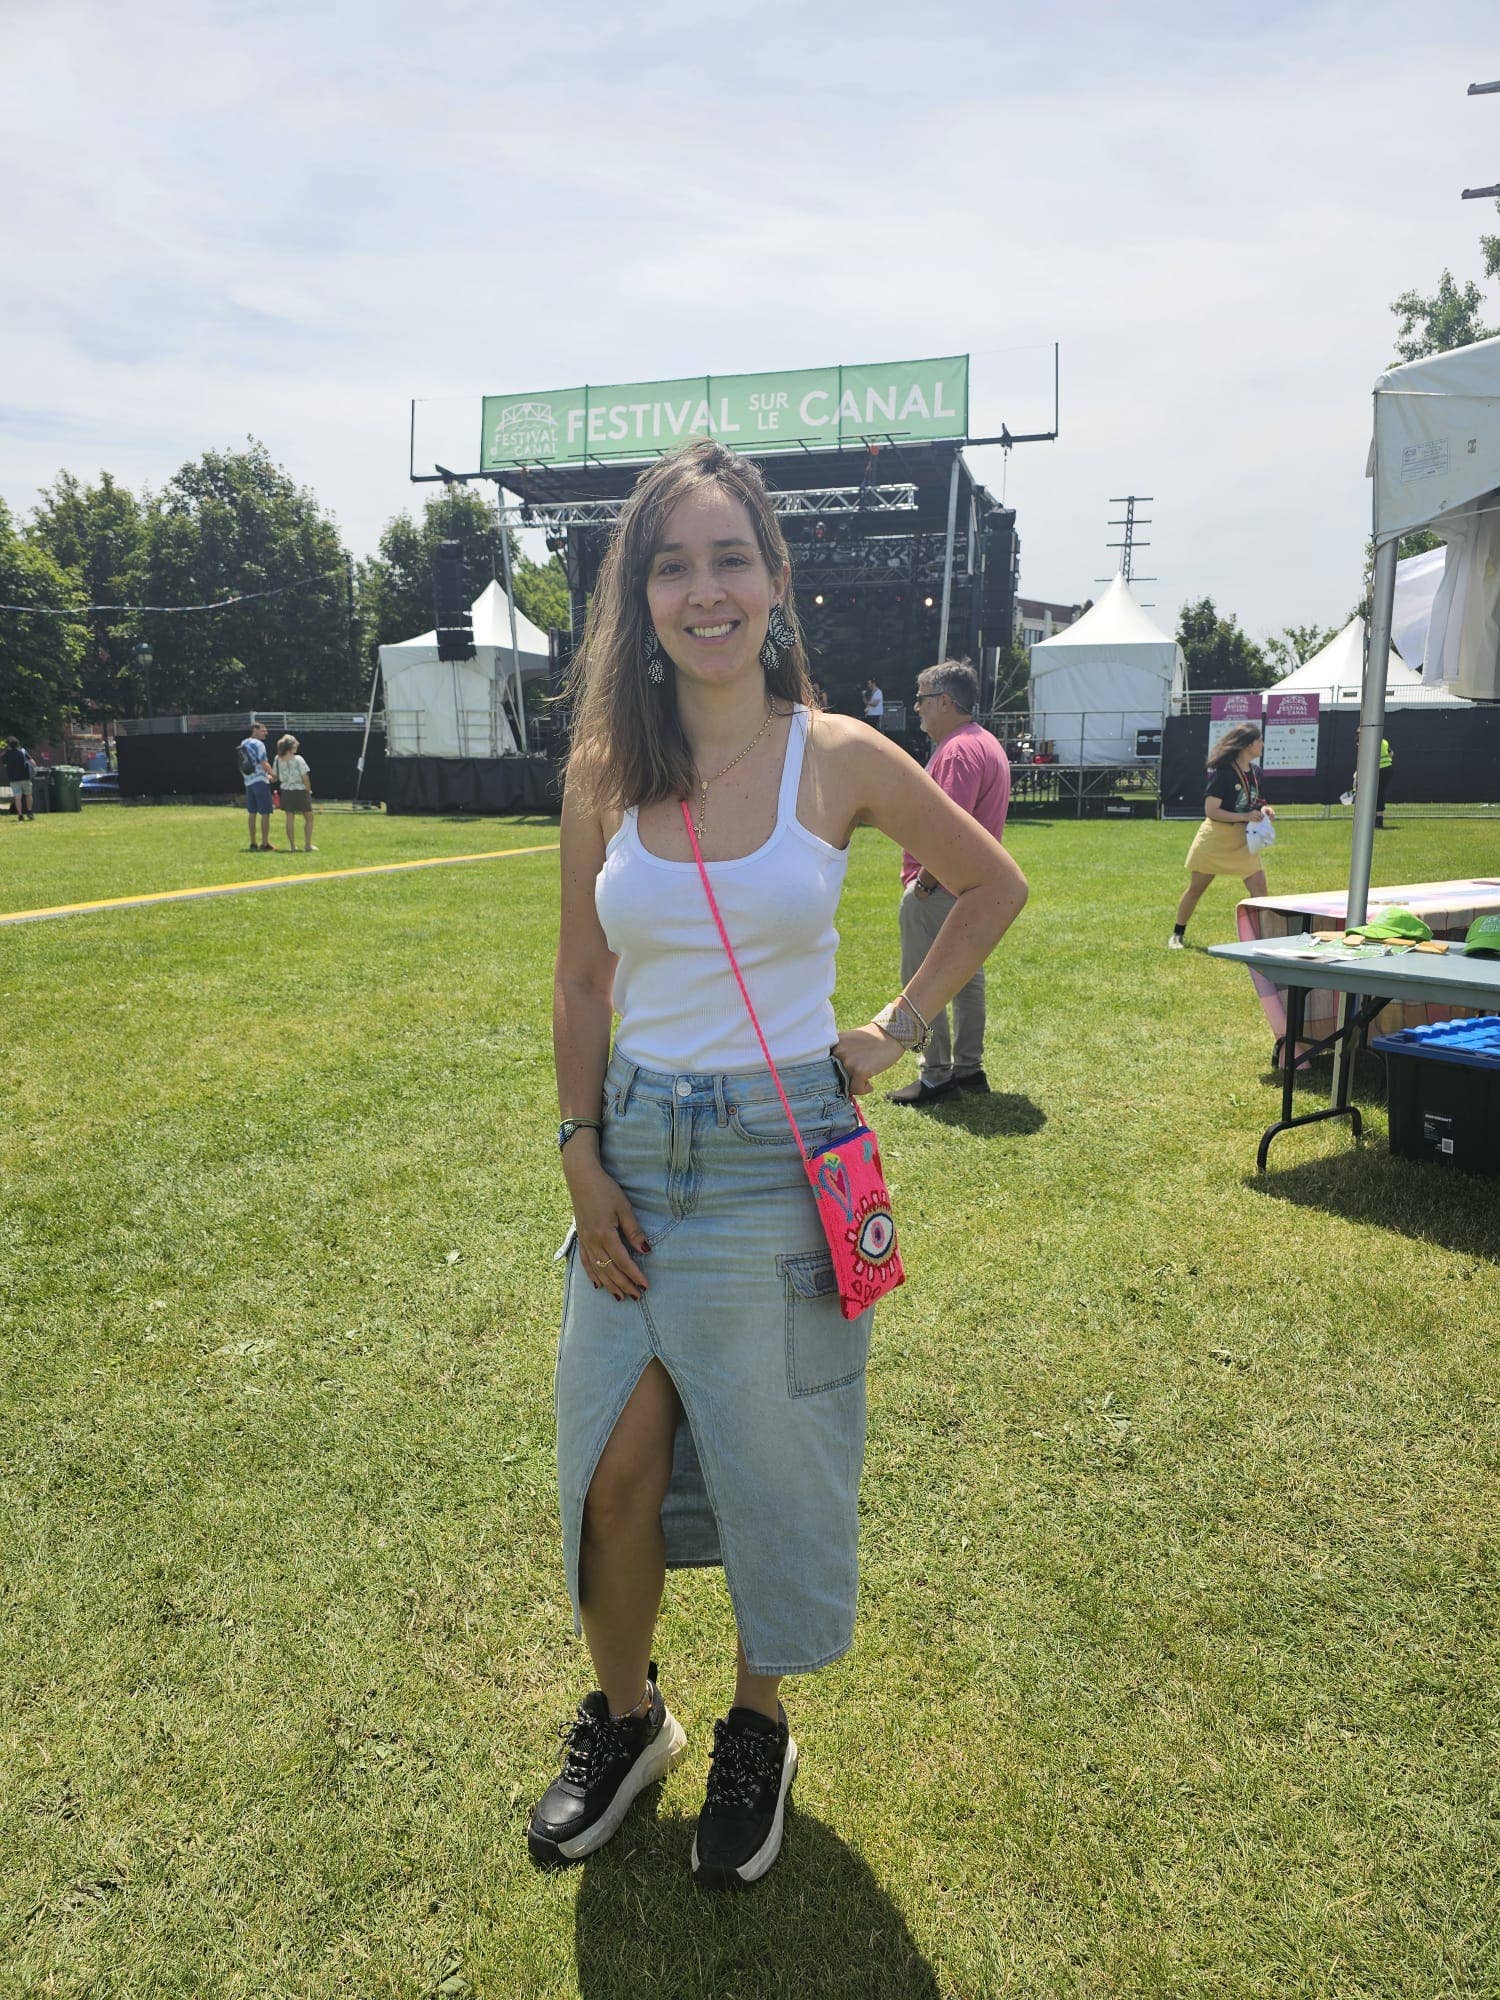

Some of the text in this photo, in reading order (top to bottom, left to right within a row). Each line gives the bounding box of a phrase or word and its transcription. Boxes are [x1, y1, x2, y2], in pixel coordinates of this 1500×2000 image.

[567, 382, 955, 443] FESTIVAL SUR LE CANAL
[495, 429, 558, 446] FESTIVAL
[514, 443, 558, 457] CANAL
